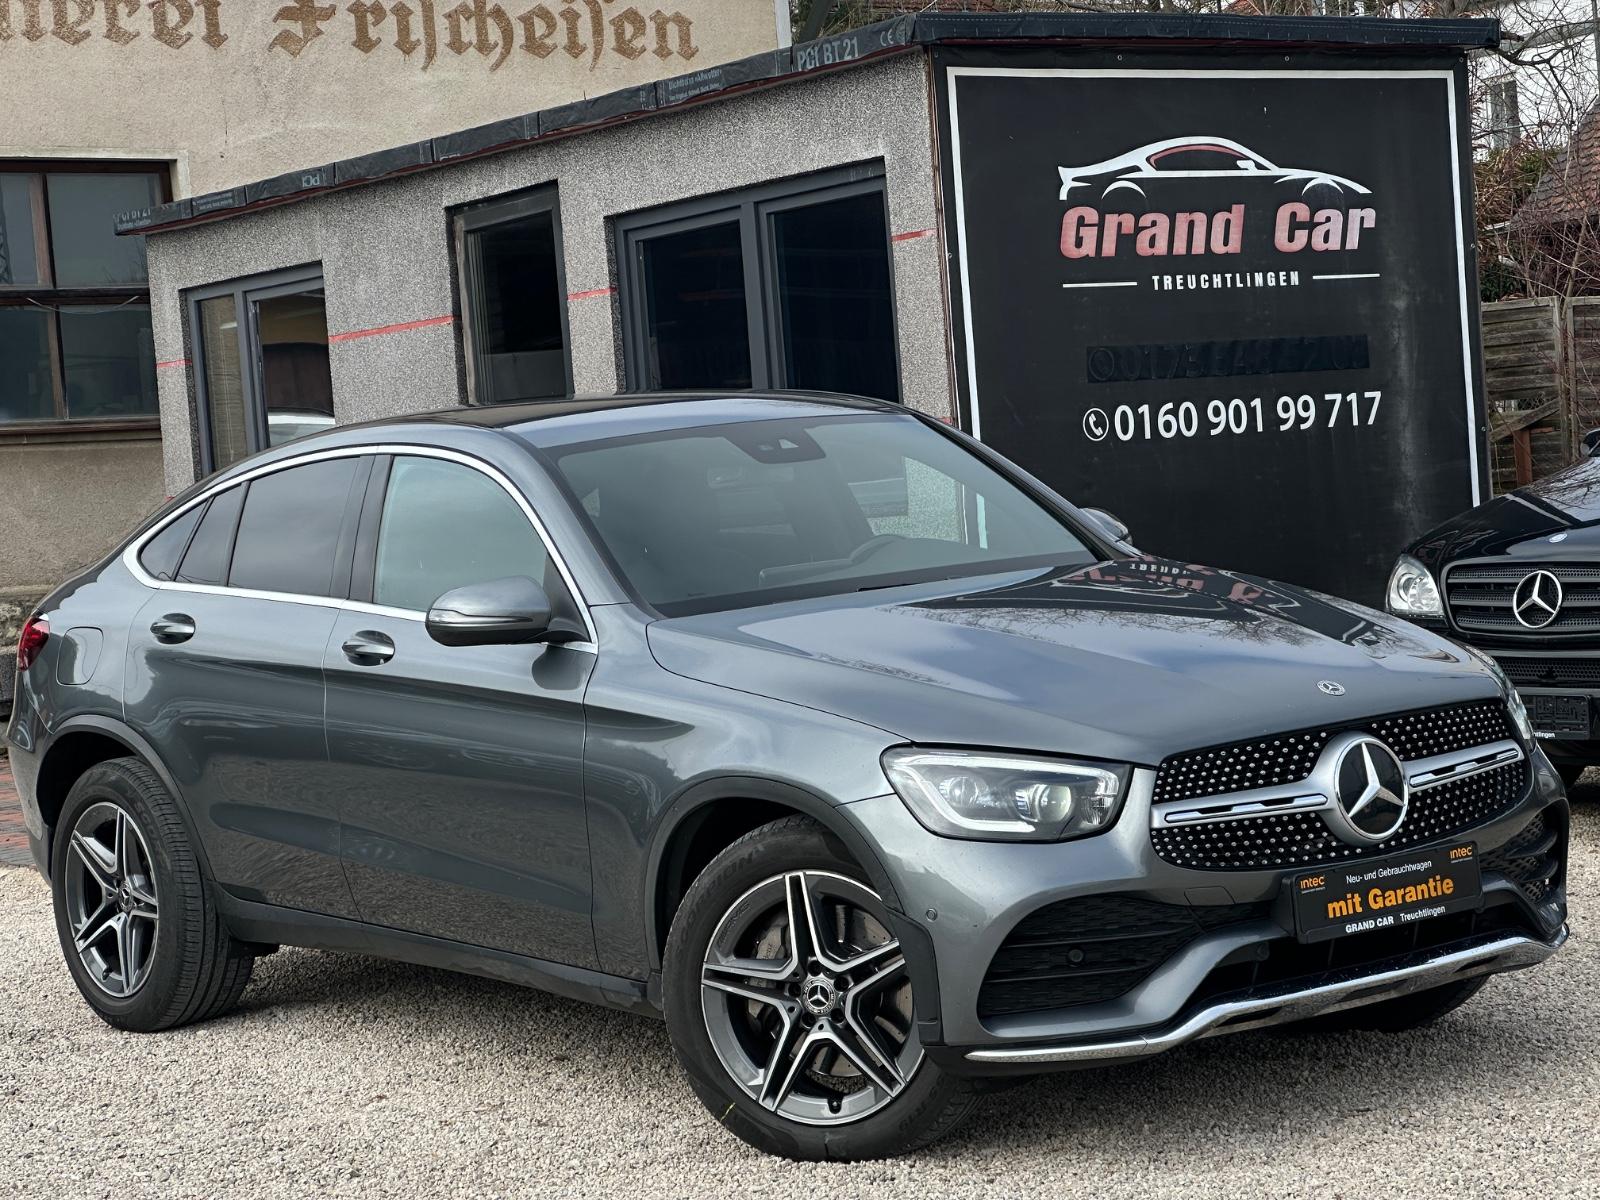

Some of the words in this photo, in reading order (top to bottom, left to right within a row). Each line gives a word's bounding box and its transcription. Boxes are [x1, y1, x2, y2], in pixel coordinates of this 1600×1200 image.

[822, 41, 840, 65] BT
[843, 36, 859, 60] 21
[1060, 204, 1245, 259] Grand
[1274, 202, 1376, 253] Car
[1114, 401, 1198, 441] 0160
[1207, 397, 1264, 436] 901
[1276, 394, 1316, 431] 99
[1324, 391, 1382, 428] 717
[1346, 874, 1363, 884] Neu-
[1364, 869, 1377, 881] und
[1377, 860, 1432, 879] Gebrauchtwagen
[1327, 896, 1362, 919] mit
[1368, 874, 1454, 910] Garantie
[1345, 919, 1375, 934] GRAND
[1376, 916, 1394, 927] CAR
[1400, 905, 1446, 923] Treuchtlingen
